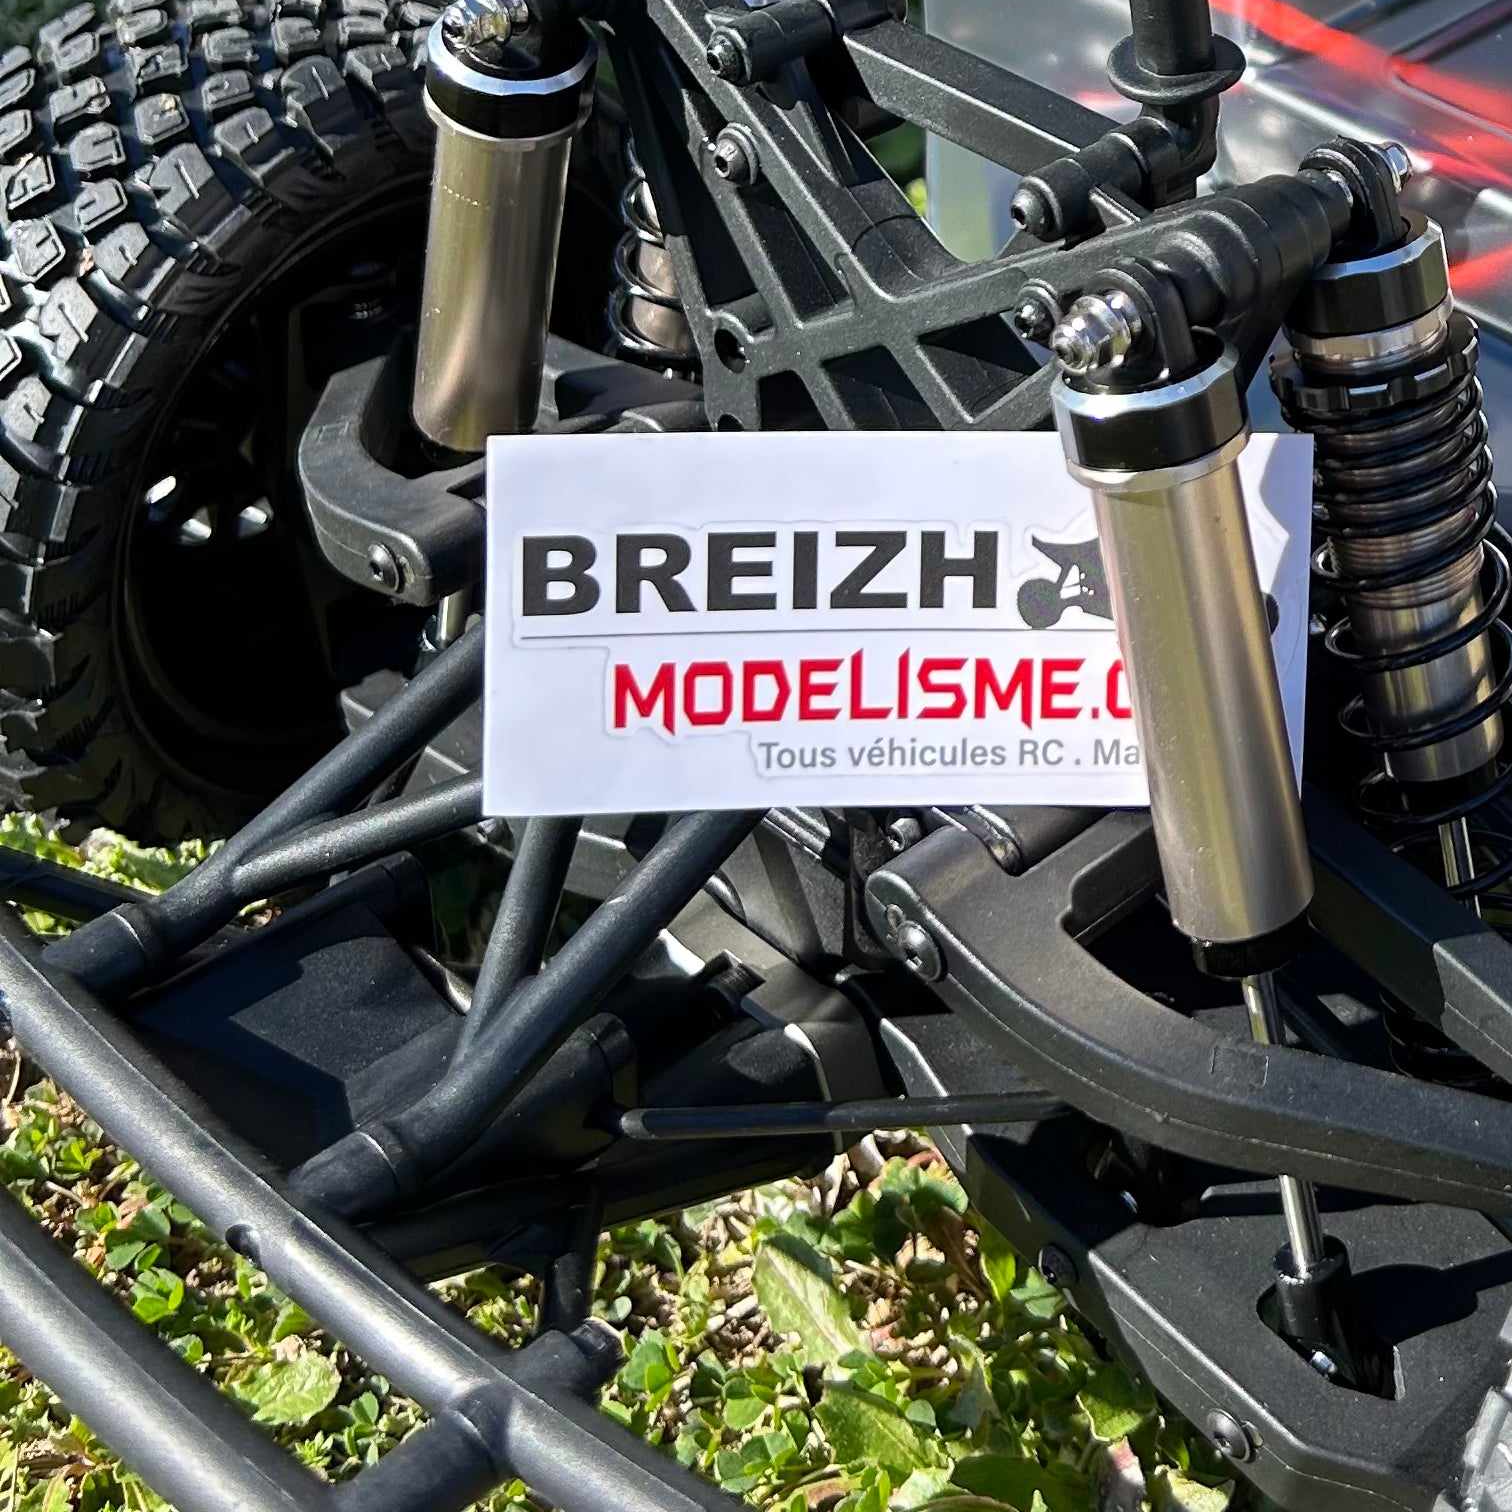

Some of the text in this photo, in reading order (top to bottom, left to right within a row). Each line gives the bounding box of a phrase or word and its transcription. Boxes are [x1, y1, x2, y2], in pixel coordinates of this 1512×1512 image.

[522, 530, 998, 617] BREIZH
[757, 741, 837, 769] Tous
[848, 737, 1007, 768] véhicules
[1018, 738, 1064, 766] RC
